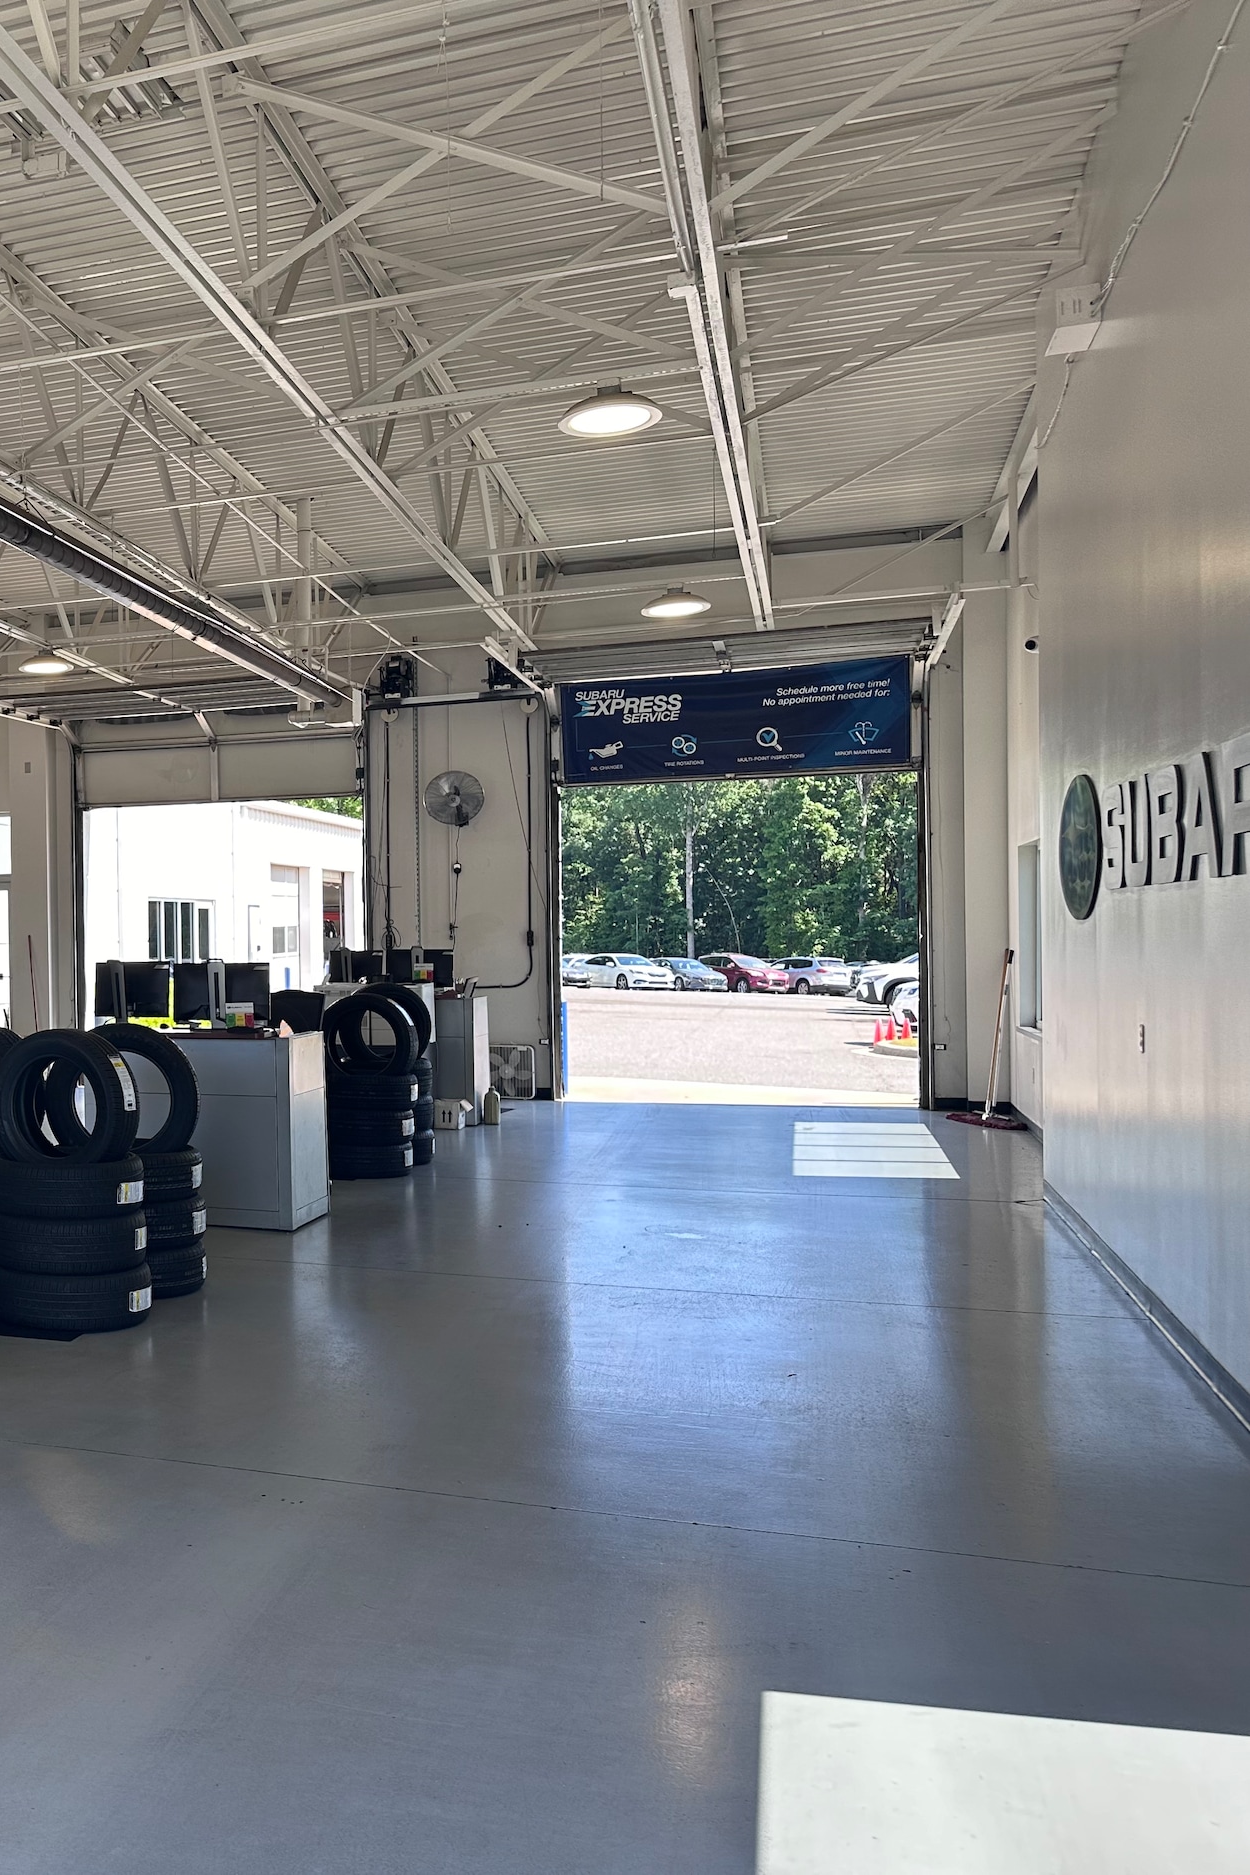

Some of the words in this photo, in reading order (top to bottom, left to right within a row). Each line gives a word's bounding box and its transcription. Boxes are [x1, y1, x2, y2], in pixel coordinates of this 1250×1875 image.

[575, 689, 625, 701] SUBARU
[776, 685, 819, 696] Schedule
[820, 683, 845, 693] more
[846, 681, 865, 690] free
[867, 678, 891, 688] time!
[573, 691, 683, 718] EXPRESS
[762, 698, 776, 706] No
[777, 693, 835, 707] appointment
[837, 689, 872, 701] needed
[874, 688, 891, 698] for:
[622, 710, 681, 724] SERVICE
[736, 755, 770, 763] MULTI-POINT
[770, 753, 805, 761] INSPECTIONS
